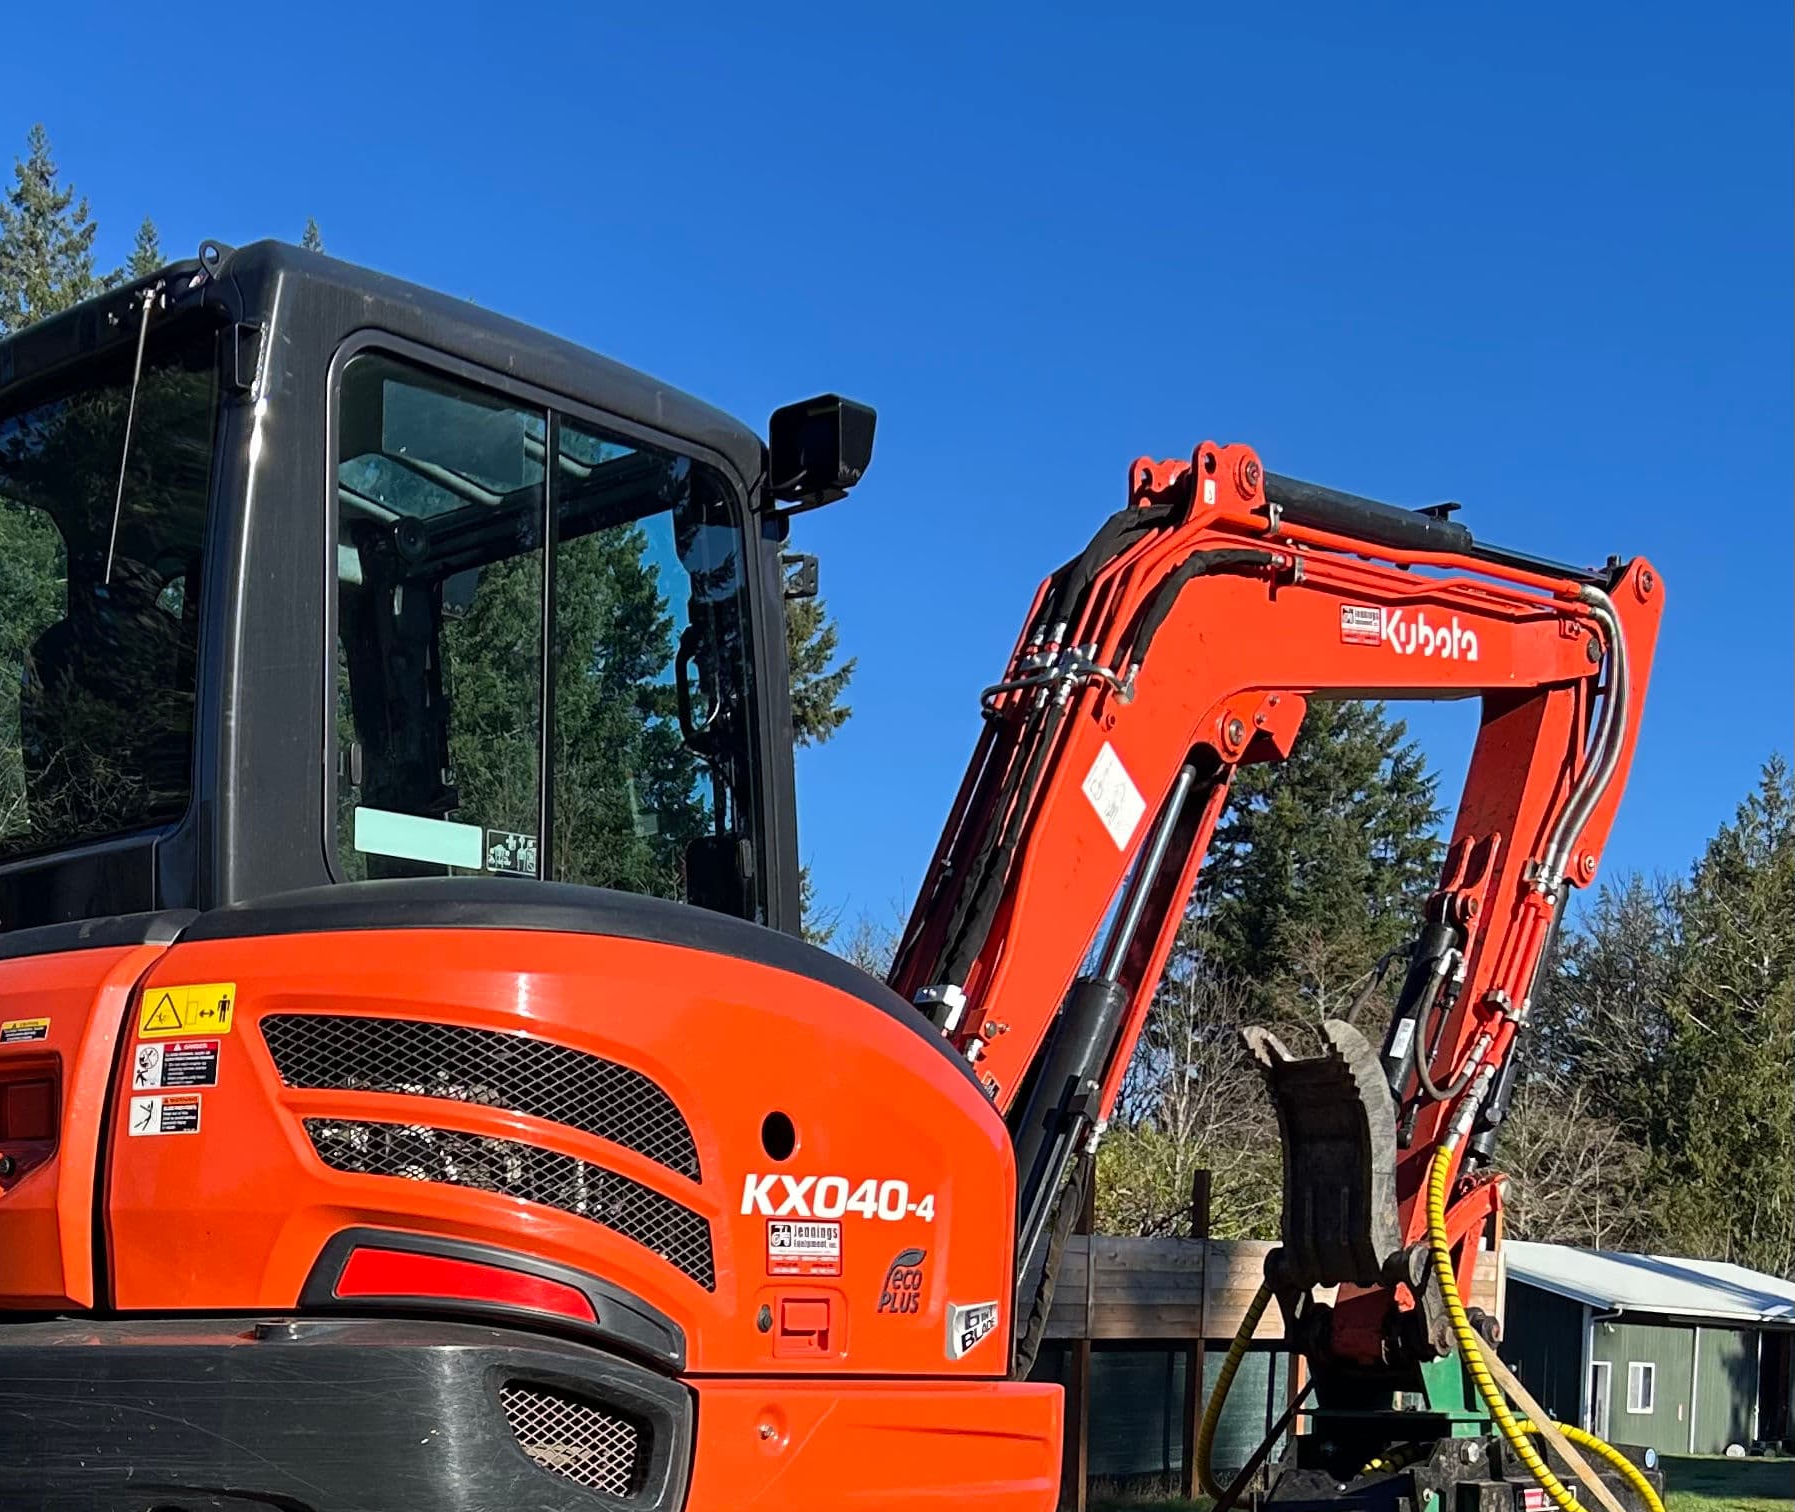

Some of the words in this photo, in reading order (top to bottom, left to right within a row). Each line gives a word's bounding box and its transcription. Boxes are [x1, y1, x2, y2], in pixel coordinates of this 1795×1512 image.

[1381, 607, 1479, 662] Kubota
[740, 1173, 935, 1222] KX040-4
[793, 1224, 838, 1241] Jennings
[891, 1269, 923, 1291] eco
[877, 1291, 920, 1314] PLUS
[961, 1317, 995, 1352] BLADE
